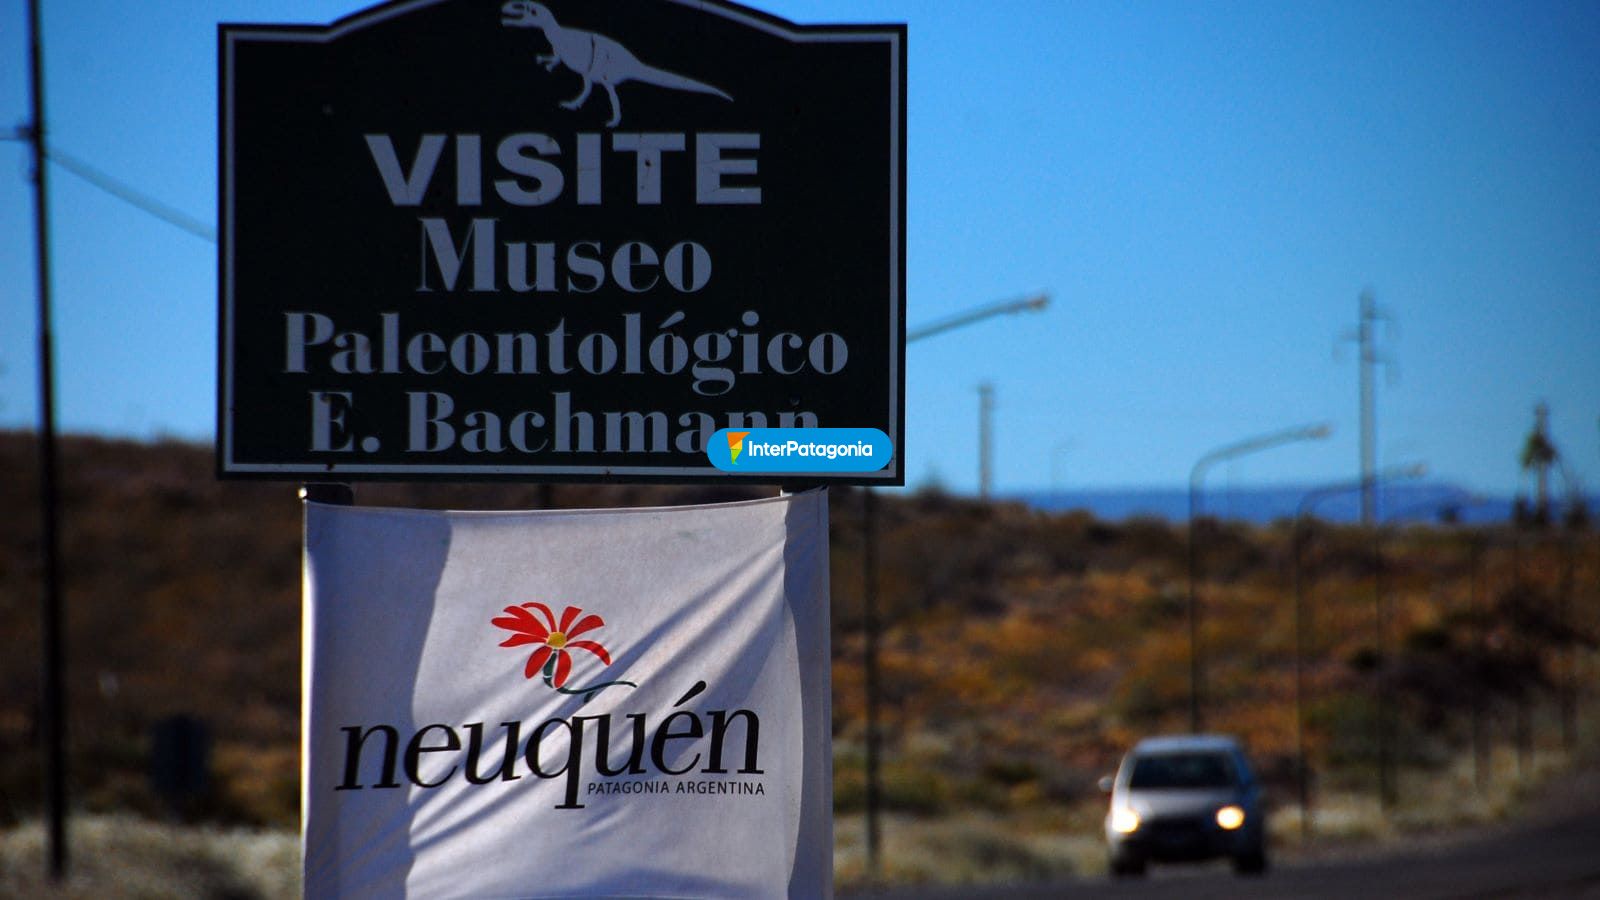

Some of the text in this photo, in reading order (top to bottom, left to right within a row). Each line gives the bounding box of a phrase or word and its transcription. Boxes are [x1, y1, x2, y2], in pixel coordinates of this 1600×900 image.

[364, 132, 762, 206] VISITE
[416, 217, 712, 293] Museo
[283, 310, 849, 396] Paleontológico
[308, 391, 381, 454] E.
[334, 680, 765, 809] neuquén
[587, 781, 766, 796] PATAGONIA ARGENTINA
